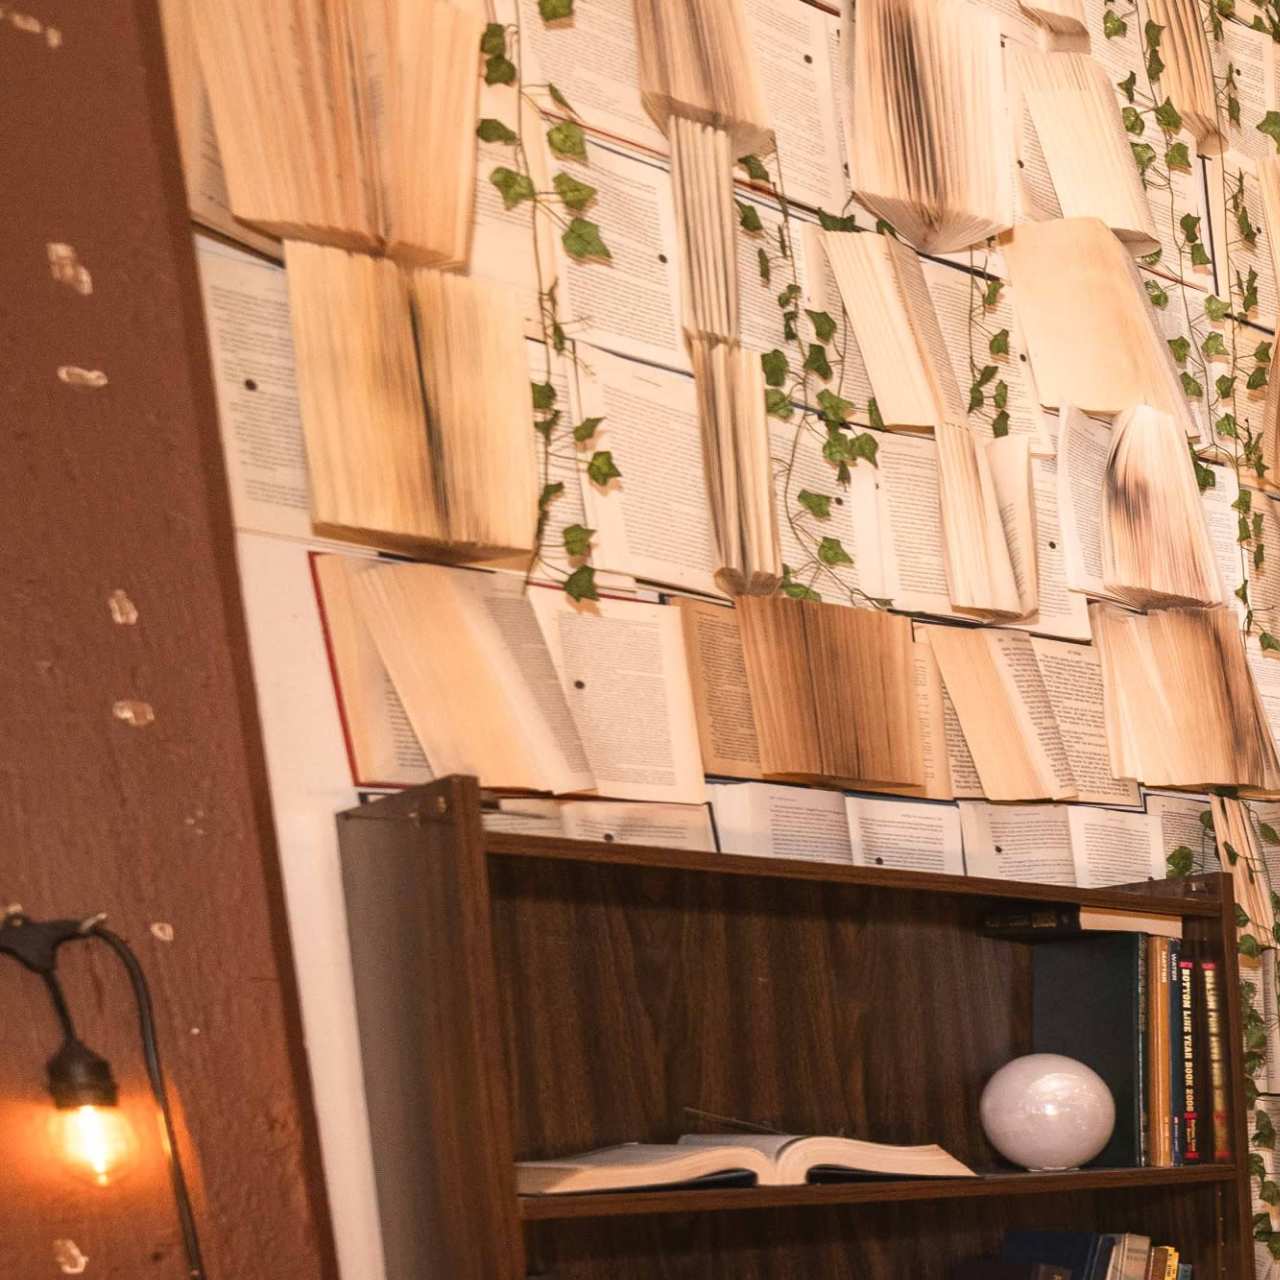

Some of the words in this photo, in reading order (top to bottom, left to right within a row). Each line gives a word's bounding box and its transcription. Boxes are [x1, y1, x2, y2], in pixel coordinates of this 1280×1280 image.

[1181, 968, 1191, 1008] BOTTOM
[1183, 1010, 1192, 1032] LINE
[1184, 1034, 1193, 1059] YEAR
[1184, 1061, 1194, 1086] BOOK
